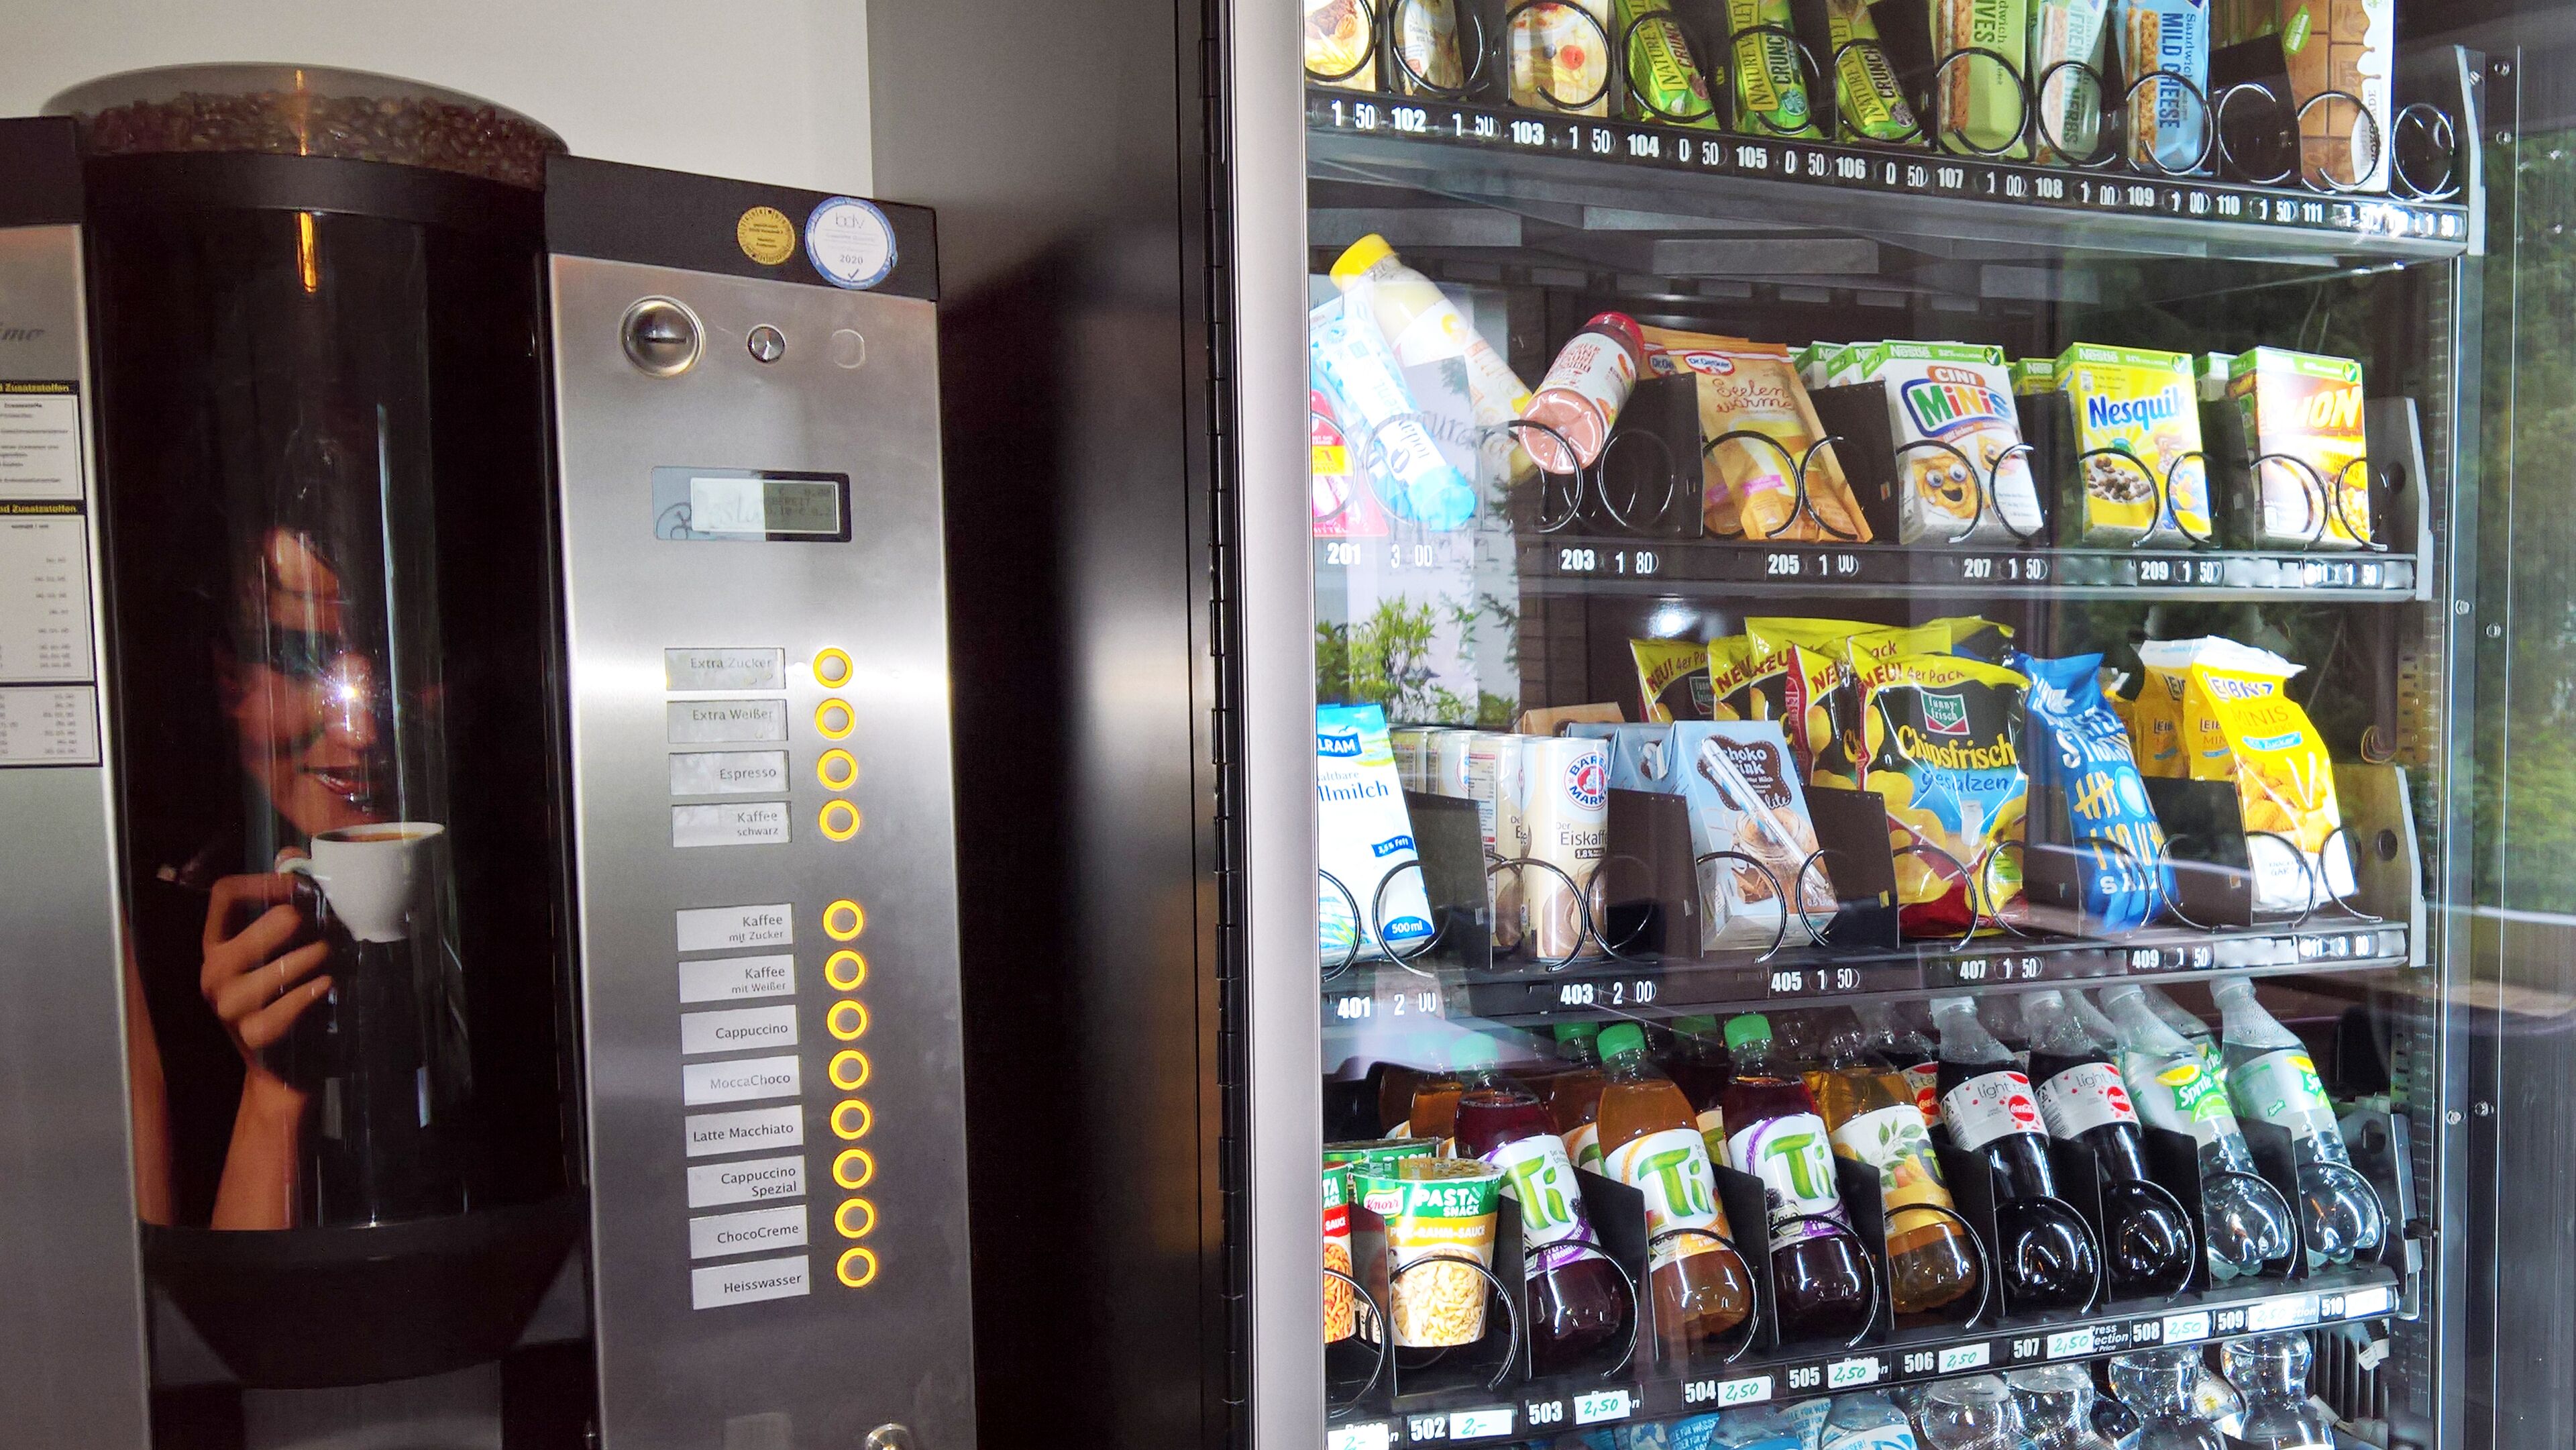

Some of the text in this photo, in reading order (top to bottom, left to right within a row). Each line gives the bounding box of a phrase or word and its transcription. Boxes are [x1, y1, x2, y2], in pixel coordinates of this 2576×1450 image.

[2161, 13, 2184, 56] MILD
[1644, 34, 1683, 85] NATURE
[1742, 50, 1773, 105] NATURE
[1332, 101, 1375, 130] 1 50
[1392, 107, 1426, 132] 102
[1453, 113, 1462, 136] 1
[1511, 121, 1611, 154] 103 1 50
[1627, 134, 1719, 166] 104 0 50
[1736, 146, 1825, 176] 105 0 50
[1836, 156, 1925, 188] 106 0 50
[1937, 168, 2023, 197] 107 1 00
[2035, 176, 2063, 199] 108
[2080, 180, 2090, 203] 1
[2127, 186, 2207, 214] 109 1 00
[2216, 195, 2241, 216] 110
[2276, 200, 2292, 223] 50
[2302, 202, 2323, 223] 111
[839, 254, 864, 265] 2020
[1935, 368, 1977, 385] CINI
[2298, 386, 2363, 430] ION
[1328, 542, 1433, 568] 201 3 00
[1561, 549, 1653, 574] 203 1 80
[1768, 554, 1800, 574] 205
[1819, 554, 1828, 576] 1
[1964, 558, 2041, 580] 207 1 50
[2141, 561, 2214, 582] 209 1 50
[691, 658, 772, 670] Extra Zucker
[1929, 670, 1966, 684] Pack
[692, 707, 773, 721] Extra Weißer
[2230, 706, 2290, 727] MINIS
[1898, 724, 2017, 770] Chipsfrisch
[720, 768, 777, 782] Espresso
[1919, 772, 2010, 794] gesalzen
[737, 811, 778, 823] Kaffee
[1556, 821, 1571, 830] Der
[737, 827, 779, 836] schwarz
[743, 914, 783, 927] Kaffee
[1391, 919, 1424, 933] 500 ml
[729, 929, 784, 943] mit Zucker
[1960, 957, 2037, 979] 407 1 50
[2132, 948, 2160, 969] 409
[2194, 947, 2209, 968] 50
[745, 966, 786, 979] Kaffee
[1771, 968, 1853, 992] 405 1 50
[732, 981, 786, 995] mit Weißer
[1560, 980, 1652, 1005] 403 2 00
[1337, 996, 1372, 1019] 401
[1394, 994, 1405, 1016] 2
[716, 1023, 789, 1040] Cappuccino
[710, 1074, 791, 1090] MoccaChoco
[1977, 1081, 2012, 1099] light
[2076, 1073, 2109, 1088] light
[2178, 1073, 2215, 1108] Sprite
[694, 1123, 794, 1143] Latte Macchiato
[720, 1167, 796, 1185] Cappuccino
[1764, 1132, 1837, 1200] Ti
[751, 1181, 797, 1198] Spezial
[1638, 1146, 1713, 1217] Ti
[1414, 1187, 1481, 1207] PASTA
[1500, 1155, 1570, 1231] Ti
[1365, 1198, 1400, 1211] Knorr
[1443, 1205, 1480, 1217] SNACK
[717, 1224, 799, 1244] ChocoCreme
[1325, 1216, 1346, 1231] SAUCE
[724, 1274, 802, 1294] Heisswasser
[2322, 1297, 2345, 1316] 510
[2089, 1325, 2118, 1335] Press
[2218, 1309, 2245, 1329] 509
[2133, 1318, 2202, 1343] 508 2,50
[2013, 1335, 2088, 1359] 507 2,50
[1904, 1352, 1977, 1374] 506 2,50
[1789, 1365, 1867, 1388] 505 2,50
[1684, 1380, 1760, 1403] 504 2,50
[1528, 1398, 1619, 1425] 503 2,50
[1410, 1417, 1446, 1442] 502
